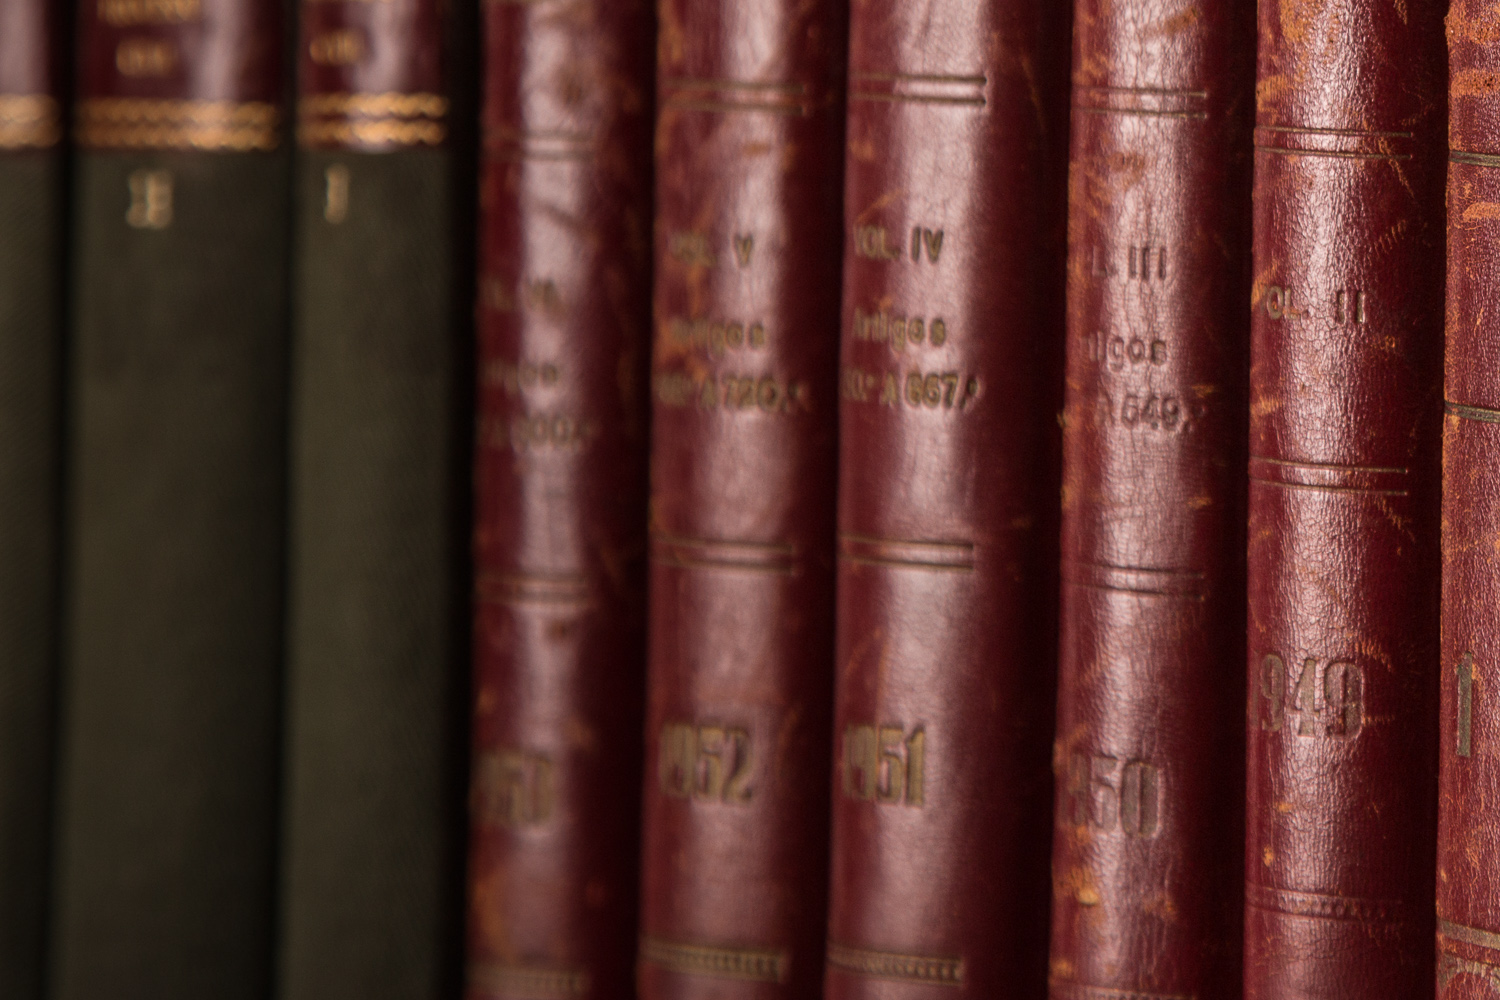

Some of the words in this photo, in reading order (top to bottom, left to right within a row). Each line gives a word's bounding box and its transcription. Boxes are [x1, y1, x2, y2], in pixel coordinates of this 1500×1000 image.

[910, 224, 945, 265] IV
[1264, 284, 1310, 321] OL.
[1261, 652, 1365, 740] 949
